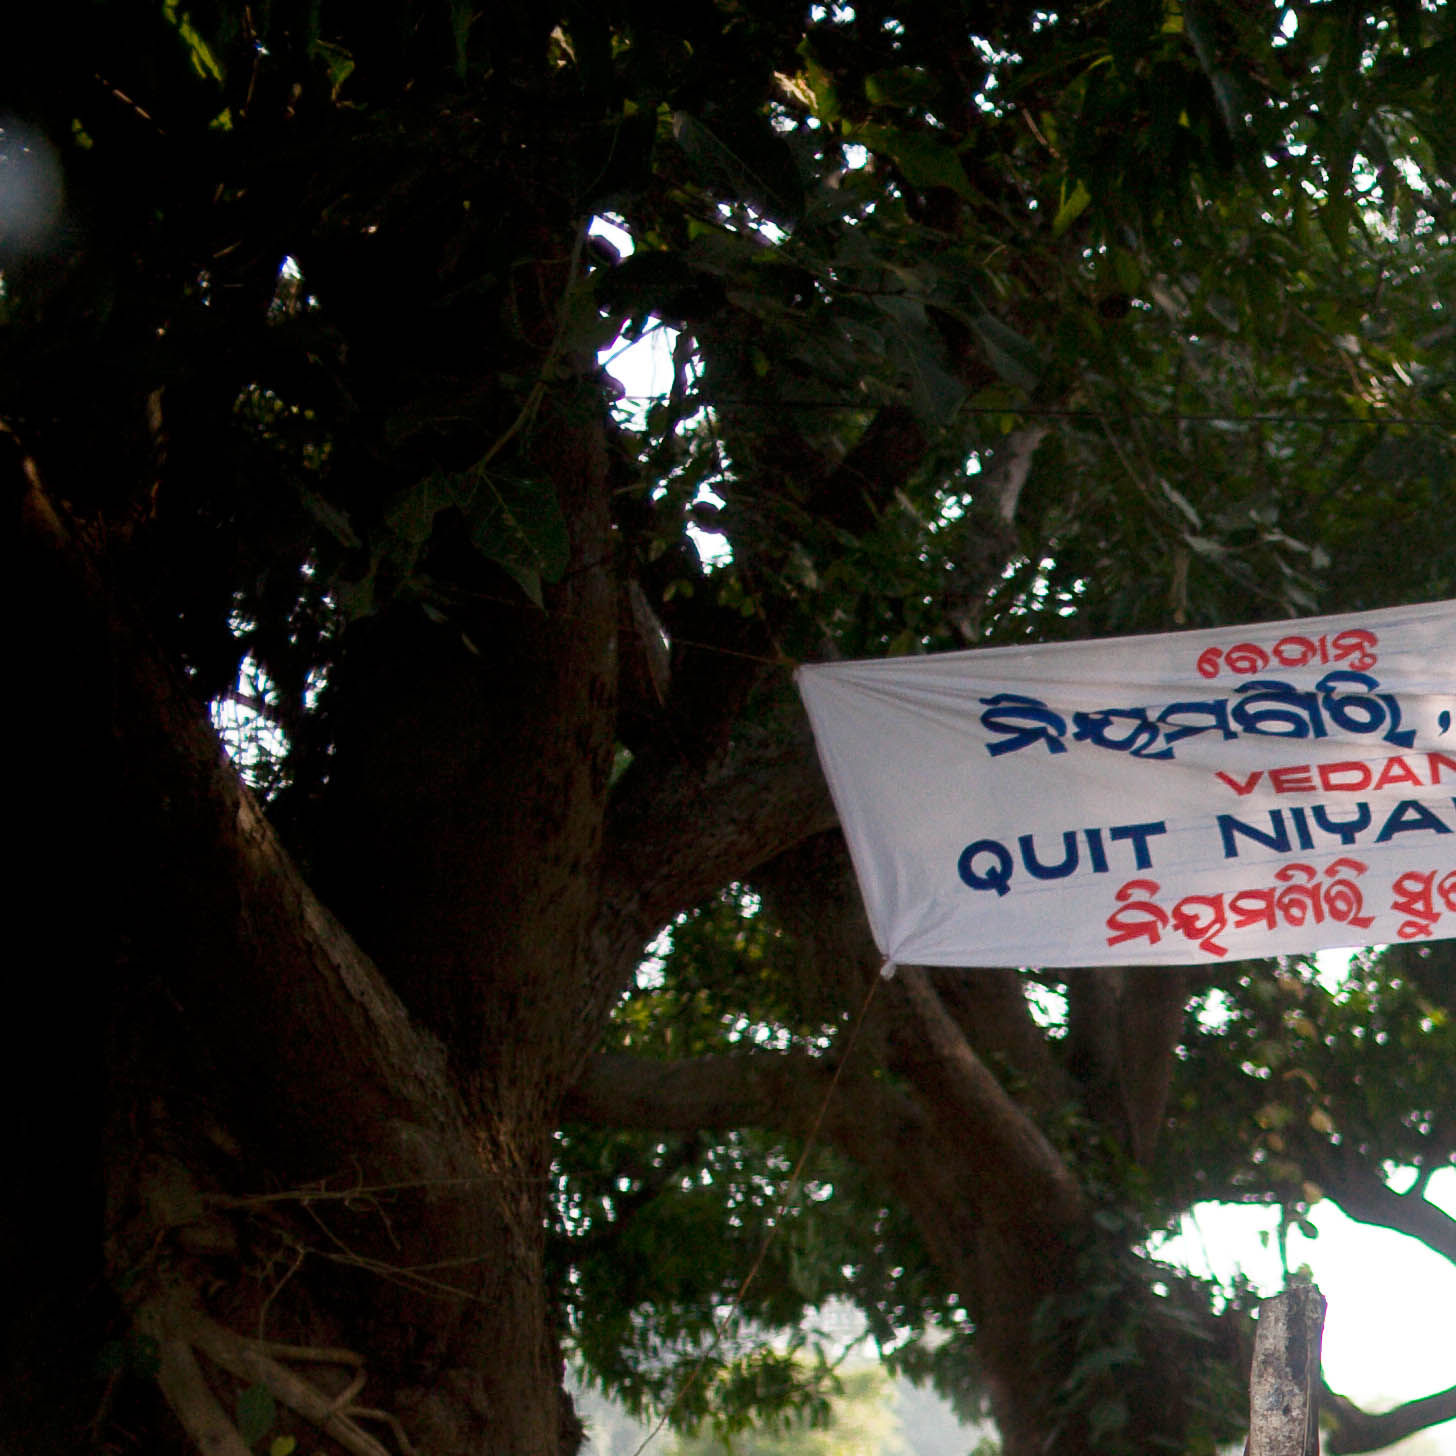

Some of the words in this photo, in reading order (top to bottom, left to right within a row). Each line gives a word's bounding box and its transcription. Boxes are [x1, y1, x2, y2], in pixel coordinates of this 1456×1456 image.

[1197, 631, 1377, 678] ବେଦାନ୍ତ
[957, 821, 1166, 896] QUIT
[1107, 858, 1374, 958] ନିୟମଗିରି
